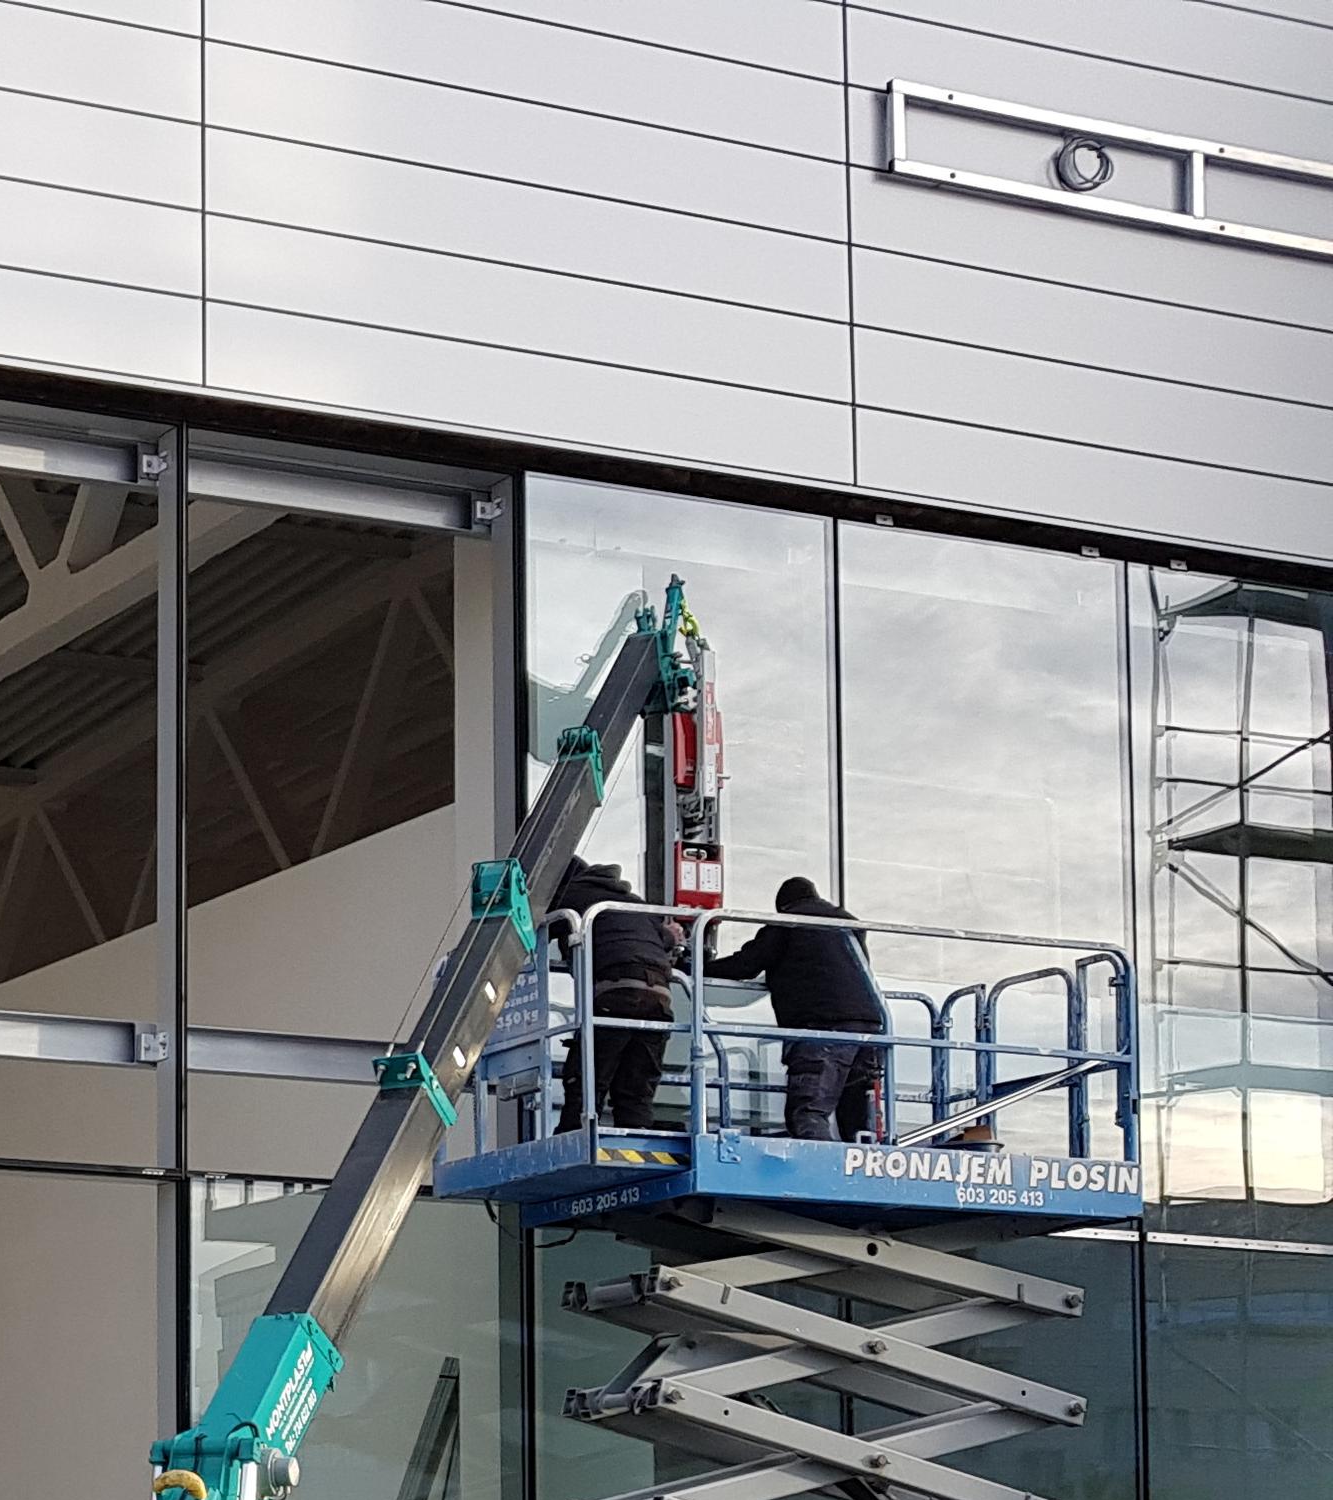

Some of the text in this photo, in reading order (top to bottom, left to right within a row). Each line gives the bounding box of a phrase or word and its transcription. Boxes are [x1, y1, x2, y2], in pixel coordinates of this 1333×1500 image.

[845, 1148, 1139, 1195] PRONAJEM PLOSIN
[571, 1187, 640, 1216] 603 205 413
[957, 1187, 1044, 1207] 603 205 413
